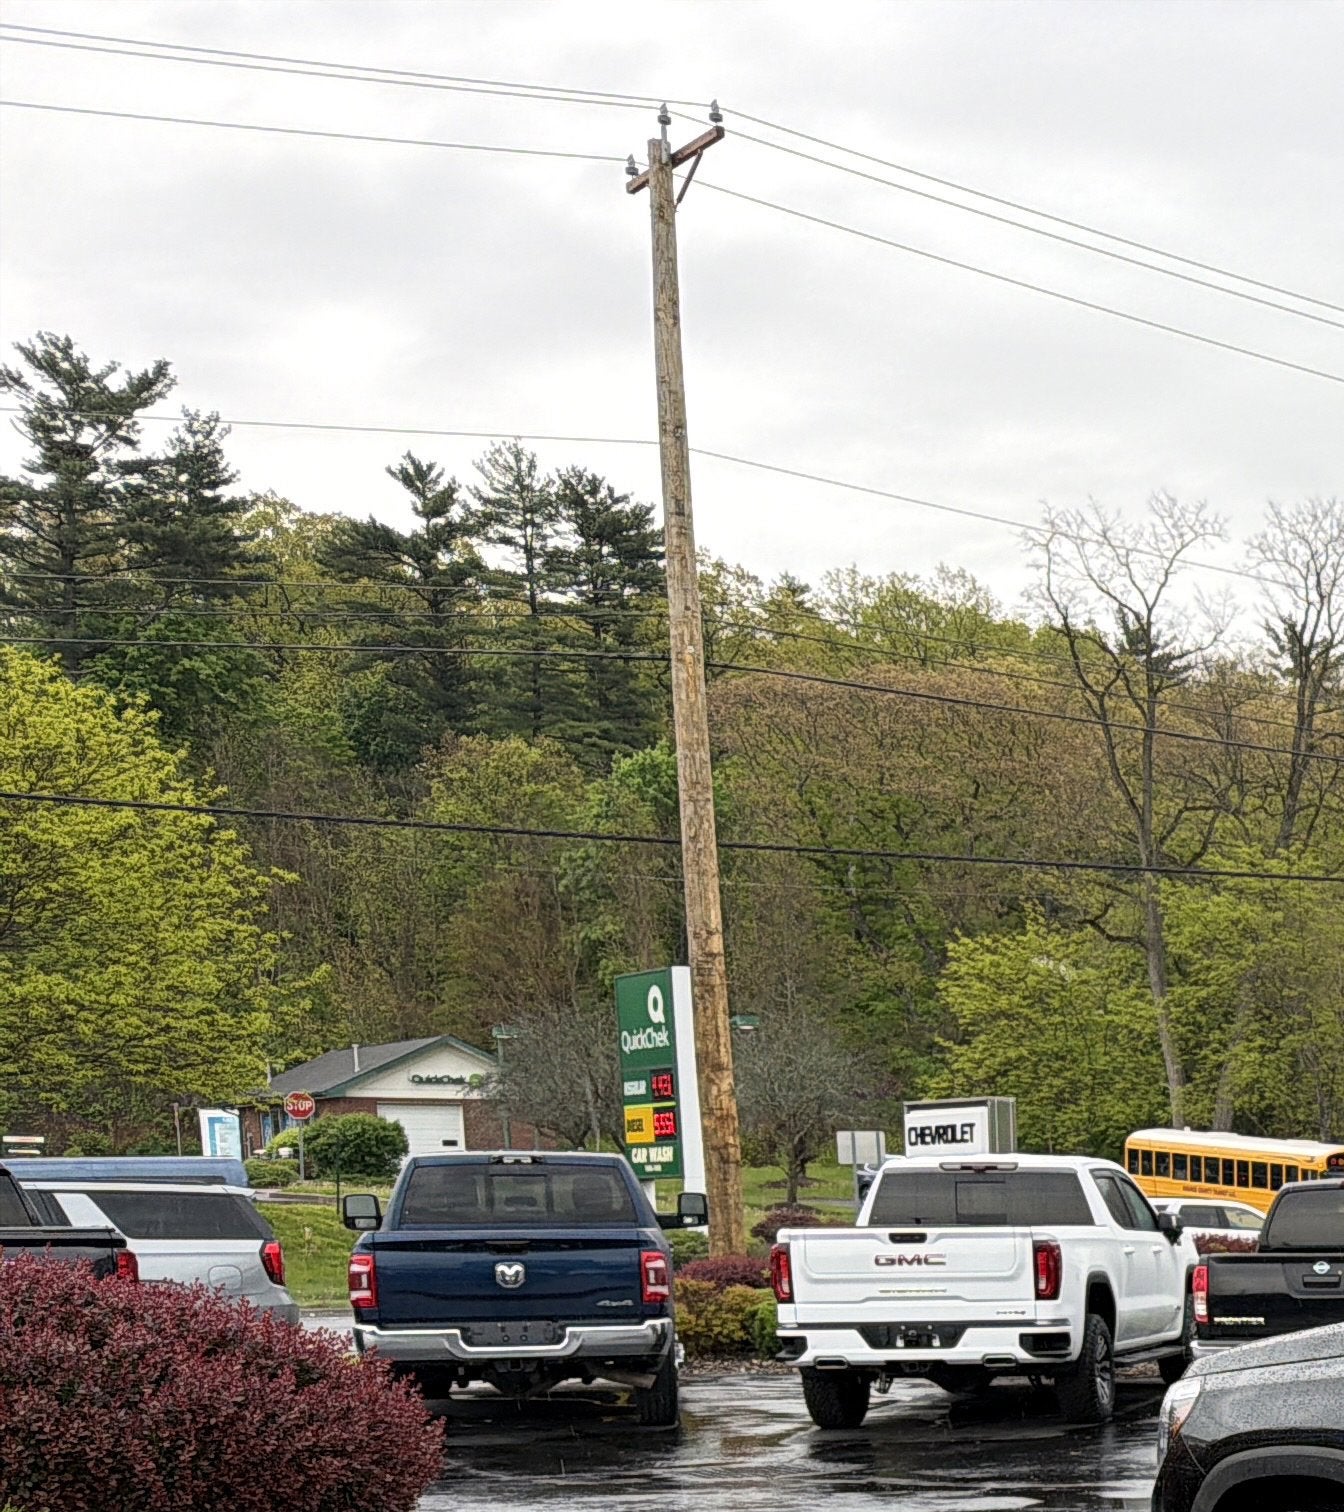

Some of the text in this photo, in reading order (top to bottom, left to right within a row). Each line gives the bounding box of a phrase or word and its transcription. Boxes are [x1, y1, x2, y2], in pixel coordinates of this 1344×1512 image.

[647, 984, 666, 1024] Q
[621, 1024, 670, 1054] QuickChek
[286, 1099, 313, 1112] STOP
[908, 1122, 976, 1146] CHEVROLET
[631, 1146, 674, 1163] CAR WASH
[874, 1253, 947, 1267] GMC
